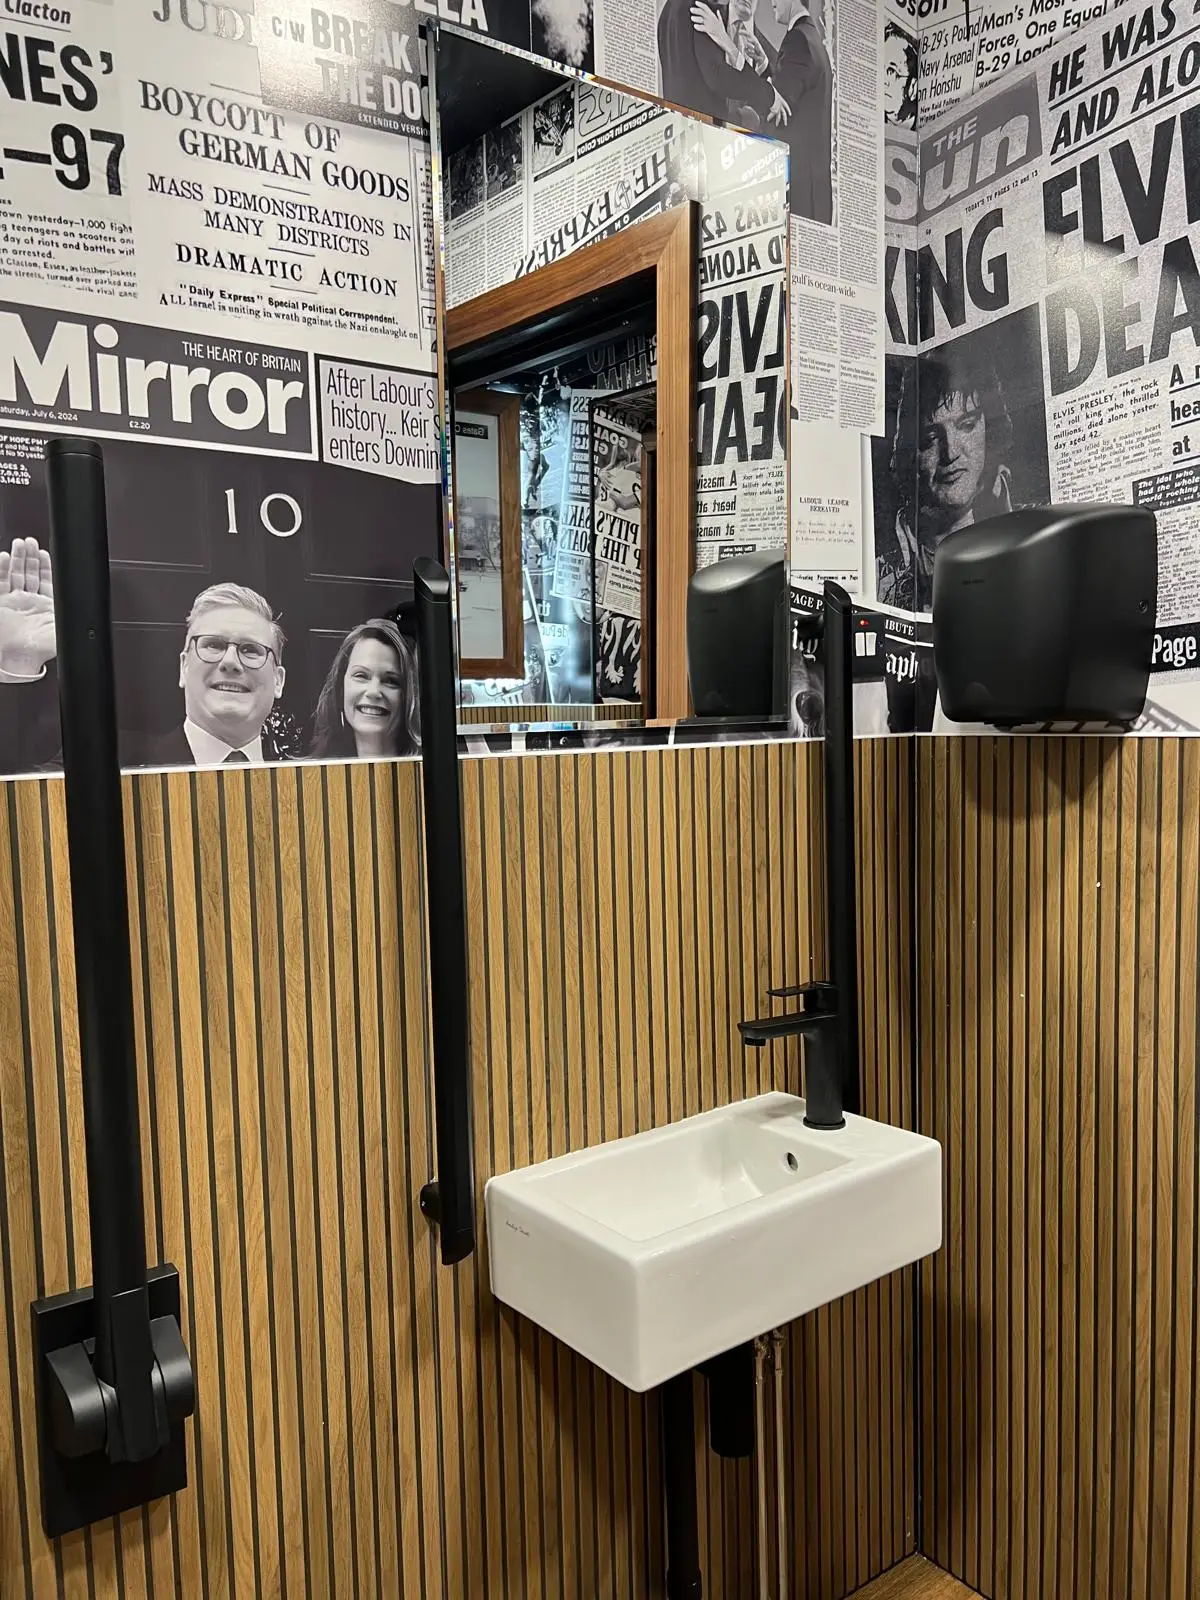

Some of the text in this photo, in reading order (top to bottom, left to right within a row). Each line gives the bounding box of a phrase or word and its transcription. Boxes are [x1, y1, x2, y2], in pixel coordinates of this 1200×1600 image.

[921, 16, 980, 55] B-29's Pound
[978, 0, 1107, 56] Force, One Equal
[981, 5, 1024, 33] Man's
[311, 8, 414, 74] BREAK
[1048, 0, 1177, 102] HE WAS
[919, 43, 975, 80] Navy Arsenal
[976, 52, 1010, 78] B-29
[315, 58, 377, 112] THE
[917, 88, 927, 102] on
[929, 74, 962, 99] Honshu
[138, 80, 341, 153] BOYCOTT OF
[358, 112, 399, 131] EXTENDED
[1050, 86, 1120, 157] AND
[932, 116, 978, 157] THE
[178, 127, 410, 203] GERMAN GOODS
[147, 173, 411, 242] MASS DEMONSTRATIONS IN
[4, 234, 20, 245] day
[38, 239, 60, 248] riots
[83, 243, 116, 255] battles
[12, 223, 60, 237] teenagers
[64, 231, 75, 239] on
[79, 233, 117, 243] scooters
[203, 209, 370, 257] MANY DISTRICTS
[12, 249, 56, 260] arrested.
[175, 243, 398, 297] DRAMATIC ACTION
[791, 273, 856, 299] gulf is ocean-wide
[189, 297, 216, 311] Israel
[218, 302, 227, 312] is
[228, 305, 261, 319] uniting
[263, 309, 272, 318] in
[274, 311, 300, 323] wrath
[302, 315, 333, 327] against
[335, 319, 348, 330] the
[349, 321, 368, 333] Nazi
[268, 297, 299, 310] Special
[302, 302, 338, 316] Political
[339, 308, 399, 326] Correspondent.
[0, 310, 304, 435] Mirror
[182, 340, 301, 373] THE HEART OF BRITAIN
[327, 367, 435, 410] After Labour's
[1169, 363, 1185, 388] A
[32, 409, 48, 419] July
[58, 412, 78, 421] 2024
[1053, 406, 1075, 421] ELVIS
[1080, 393, 1117, 411] PRESLEY,
[1122, 387, 1136, 398] the
[1140, 379, 1159, 392] rock
[1068, 415, 1080, 426] roll
[1085, 409, 1102, 420] king
[1107, 402, 1124, 413] who
[1130, 388, 1160, 405] thrilled
[129, 420, 151, 430] £2.20
[331, 399, 430, 440] history... Keir
[1053, 427, 1084, 441] millions,
[1087, 419, 1104, 430] died
[1107, 411, 1128, 424] alone
[9, 436, 30, 444] HOPE
[330, 433, 442, 471] enters Downin
[1054, 441, 1067, 451] day
[1069, 434, 1086, 446] aged
[1172, 435, 1191, 457] at
[1138, 479, 1153, 490] The
[1175, 468, 1194, 481] who
[1138, 486, 1154, 497] had
[1157, 480, 1171, 492] the
[1138, 485, 1199, 505] world rocking
[885, 618, 914, 636] IBUTE
[1151, 633, 1197, 668] Page
